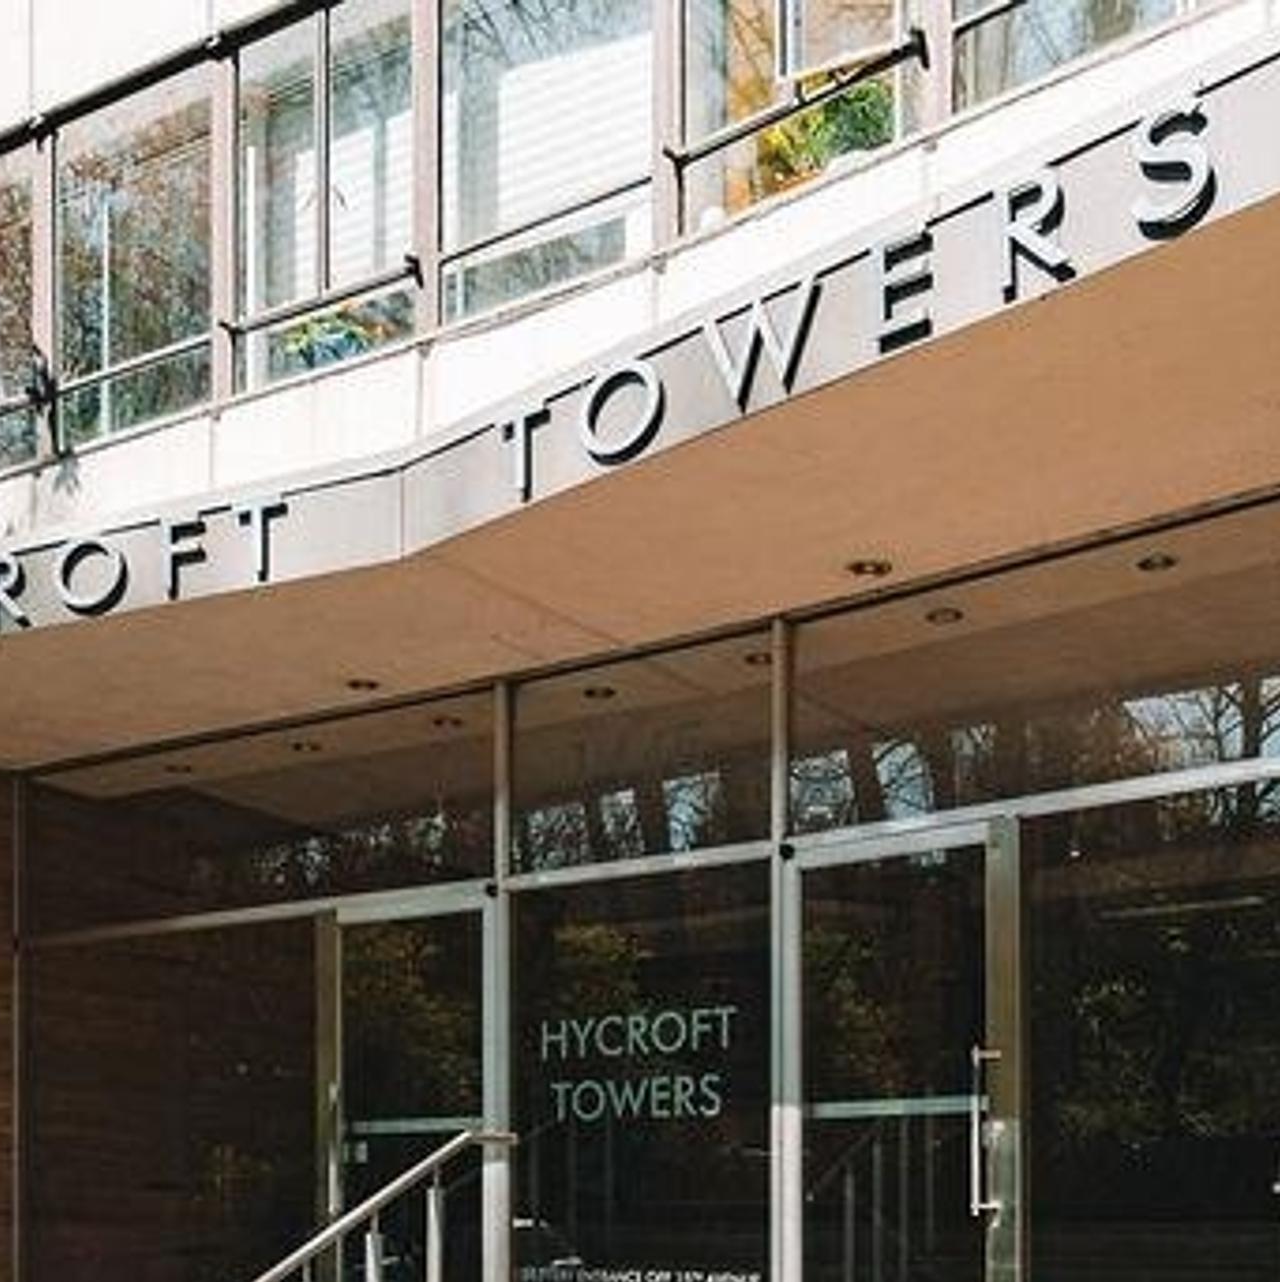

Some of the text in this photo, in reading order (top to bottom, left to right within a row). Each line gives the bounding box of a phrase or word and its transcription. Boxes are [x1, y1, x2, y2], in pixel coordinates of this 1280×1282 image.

[495, 92, 1220, 504] TOWERS
[540, 1004, 739, 1062] HYCROFT
[550, 1072, 722, 1122] TOWERS
